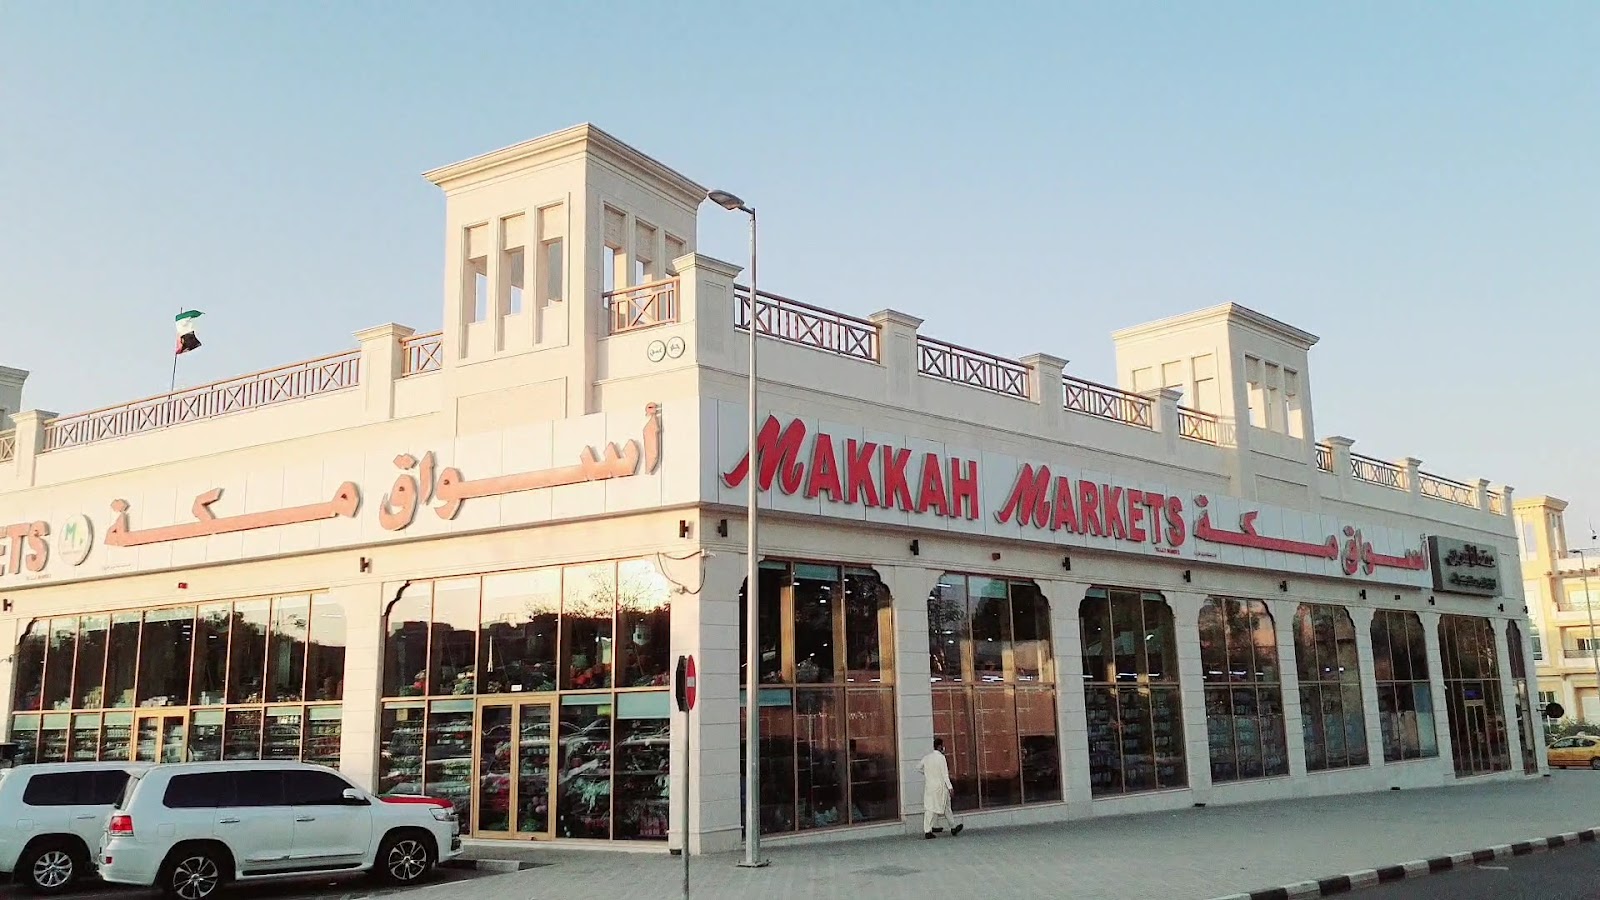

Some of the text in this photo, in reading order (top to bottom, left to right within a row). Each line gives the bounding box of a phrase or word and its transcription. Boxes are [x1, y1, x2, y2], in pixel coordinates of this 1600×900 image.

[104, 402, 662, 547] أسواق مكة
[722, 415, 1185, 546] MAKKAH MARKETS
[1194, 495, 1338, 560] مكة
